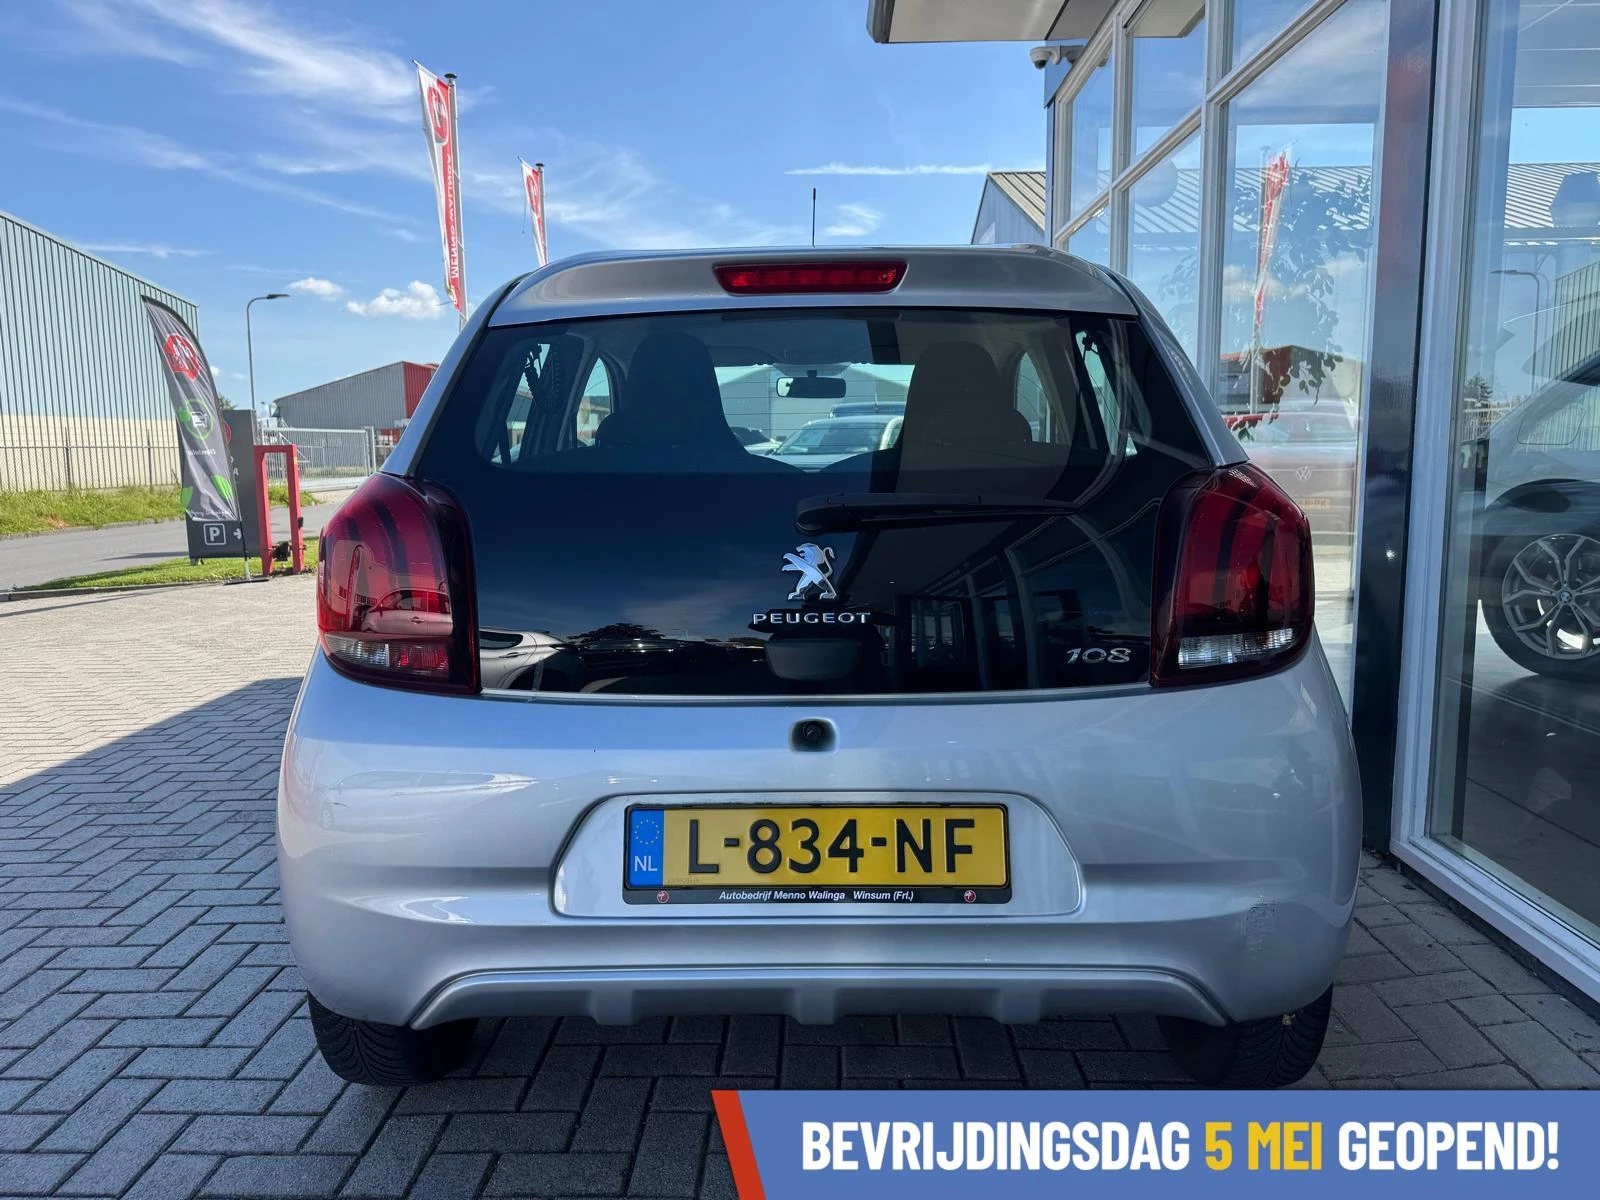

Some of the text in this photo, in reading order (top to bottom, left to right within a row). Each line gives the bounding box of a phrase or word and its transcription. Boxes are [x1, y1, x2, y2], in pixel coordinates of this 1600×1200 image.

[209, 527, 221, 542] P
[753, 612, 871, 625] PEUGEOT
[1066, 647, 1132, 664] 108
[688, 818, 976, 875] L-834-NF
[634, 856, 658, 872] NL
[718, 890, 914, 902] Autobedrijf Menno Walinga Winsum (Frl.)
